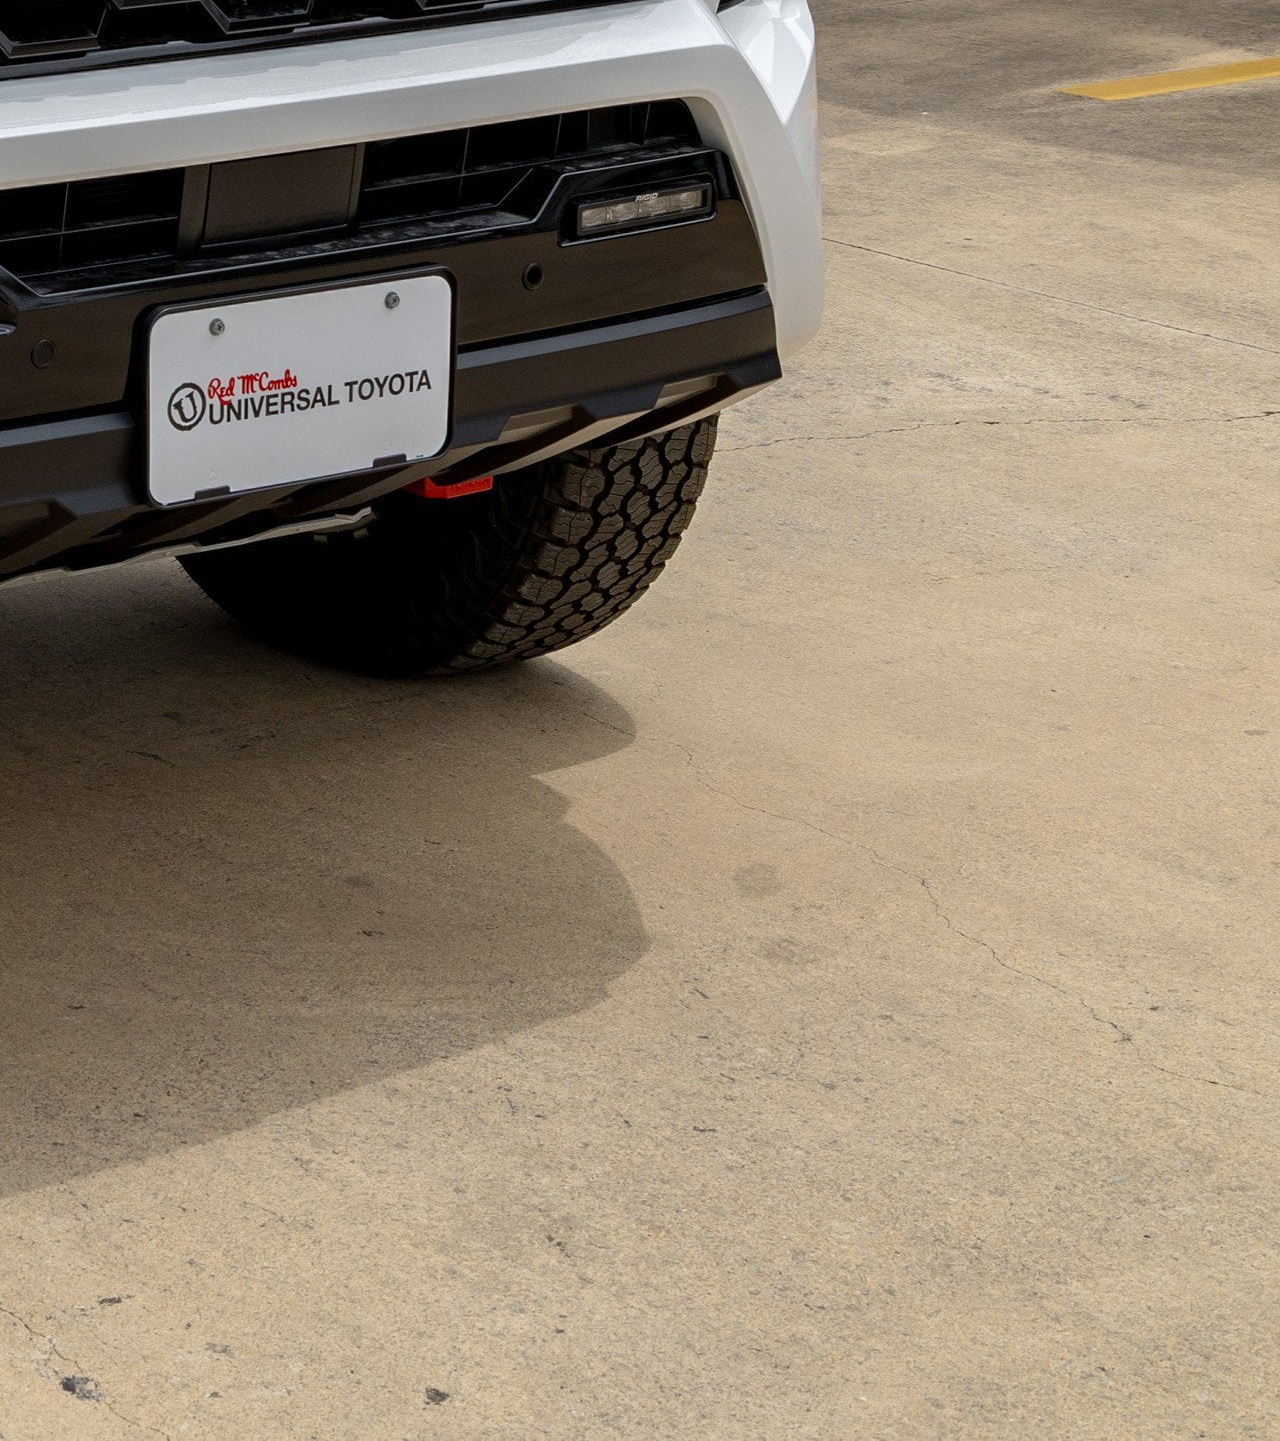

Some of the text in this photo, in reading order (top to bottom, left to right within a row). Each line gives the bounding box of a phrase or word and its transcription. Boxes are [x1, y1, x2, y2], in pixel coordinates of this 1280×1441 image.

[635, 192, 659, 203] RIGID
[208, 368, 298, 406] Red McCombs
[208, 384, 341, 426] UNIVERSAL
[344, 369, 433, 403] TOYOTA
